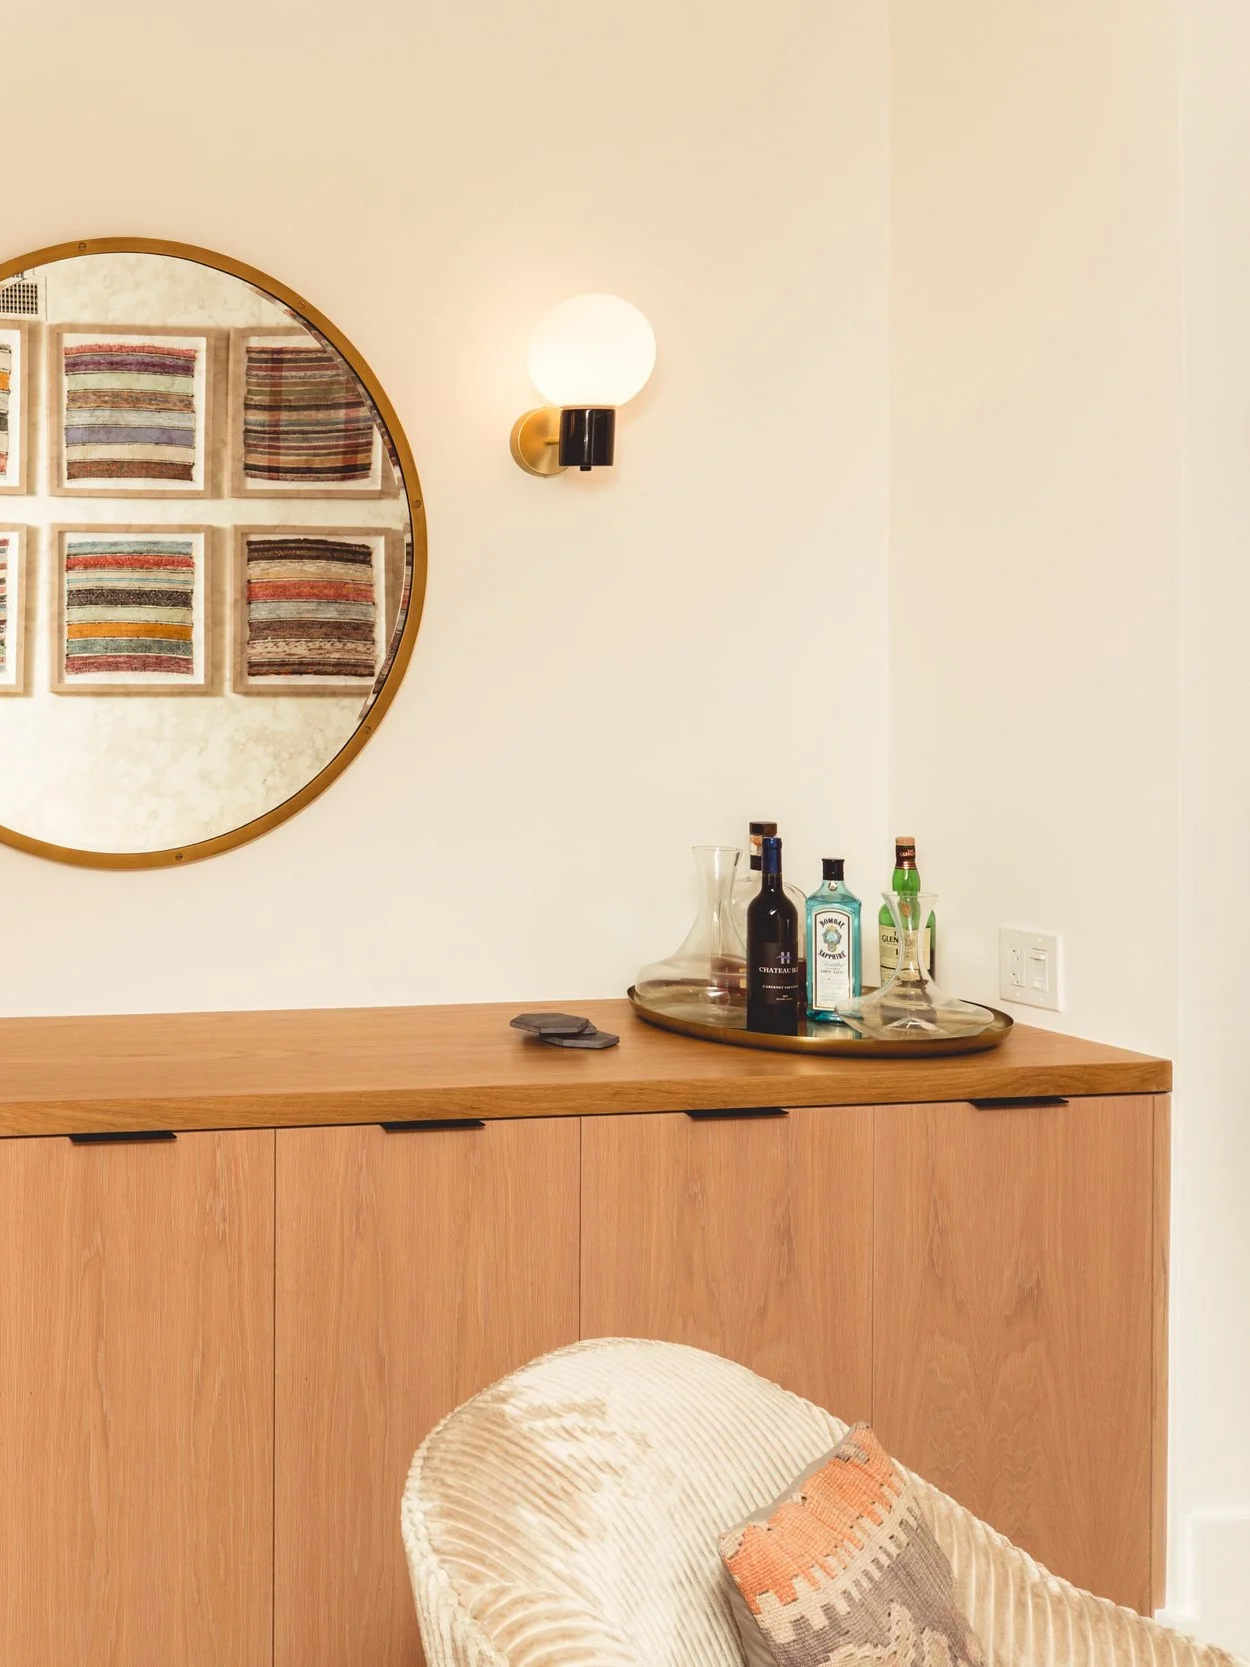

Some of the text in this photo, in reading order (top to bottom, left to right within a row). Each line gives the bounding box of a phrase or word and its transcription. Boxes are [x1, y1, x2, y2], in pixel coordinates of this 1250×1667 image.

[819, 918, 846, 929] BOMBAY
[881, 935, 899, 943] GLEN
[818, 949, 846, 960] SAPPHIRE
